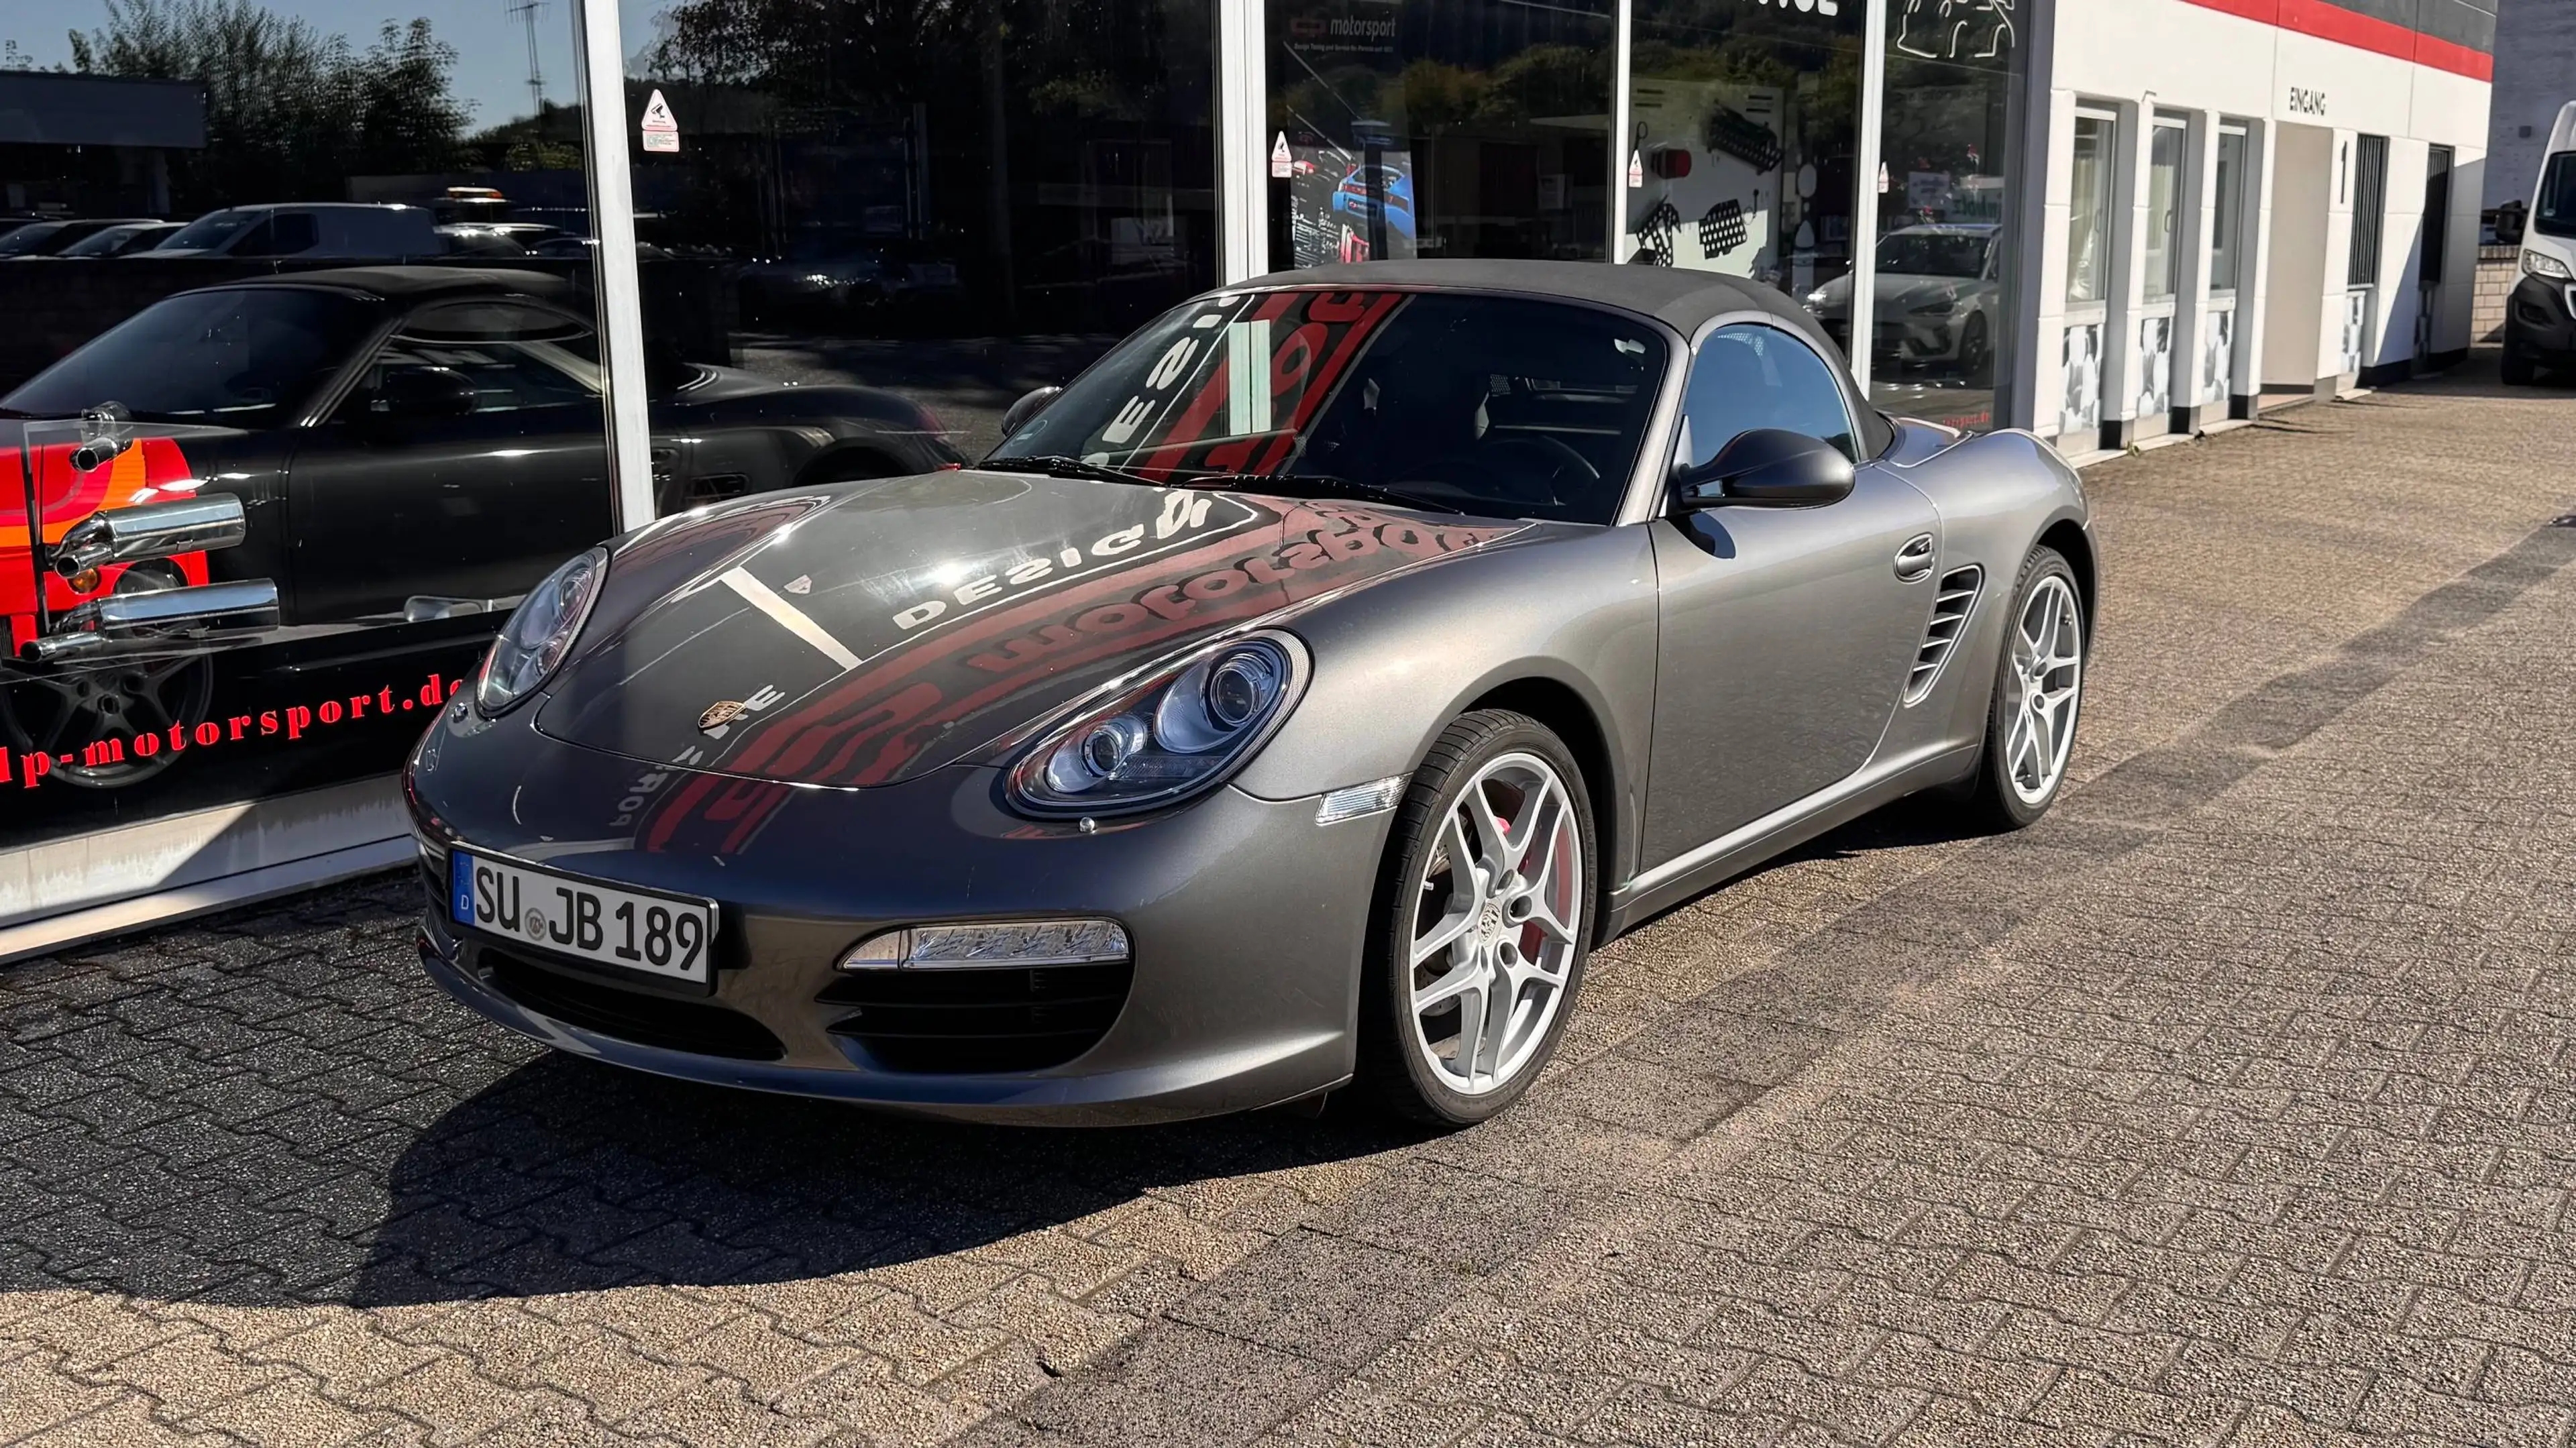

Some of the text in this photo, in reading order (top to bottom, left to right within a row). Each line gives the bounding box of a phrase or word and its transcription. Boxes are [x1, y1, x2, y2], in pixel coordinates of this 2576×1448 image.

[1330, 14, 1396, 42] motorsport
[2290, 87, 2326, 116] EINGANG
[461, 895, 469, 911] D
[476, 866, 704, 971] SU JB 189
